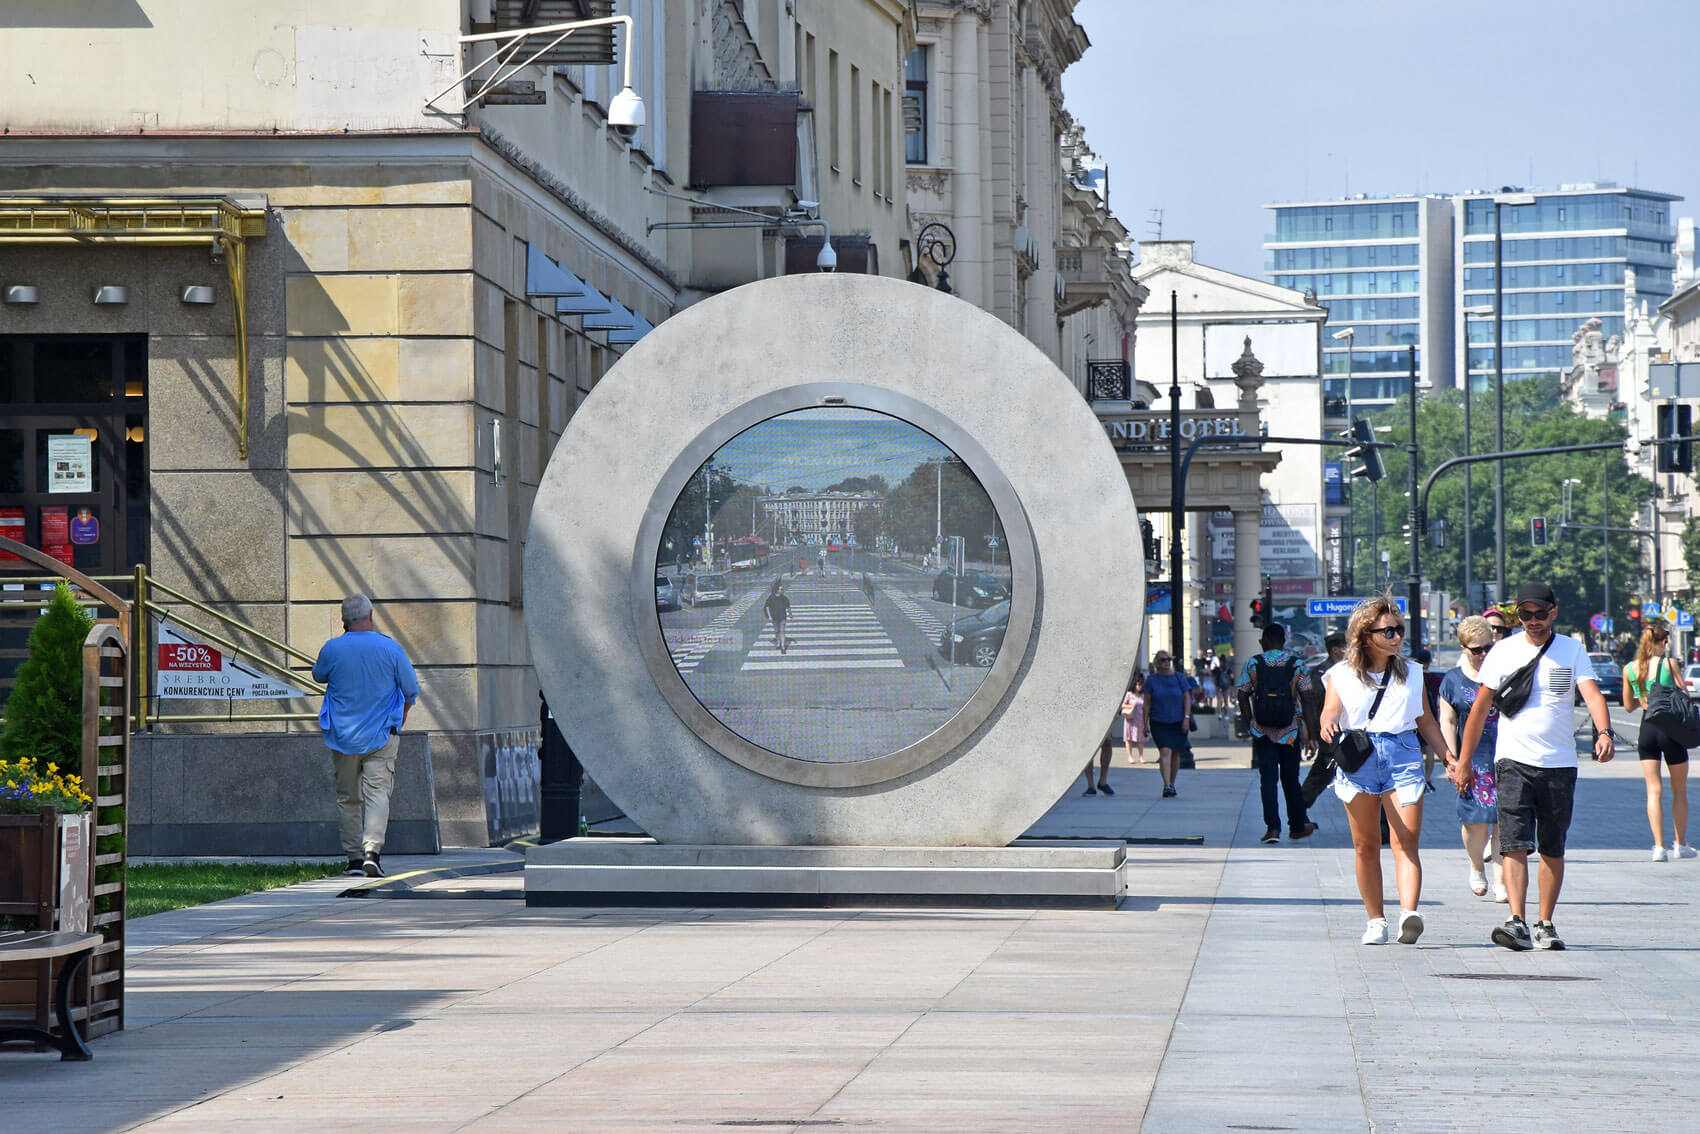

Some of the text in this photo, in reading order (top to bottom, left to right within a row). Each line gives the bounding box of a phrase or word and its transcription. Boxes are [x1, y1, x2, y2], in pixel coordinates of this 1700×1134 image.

[1111, 420, 1246, 438] ND HOTEL
[1313, 603, 1356, 614] ul. Hugon
[169, 647, 211, 662] -50%
[163, 674, 231, 685] SREBRO
[163, 687, 246, 697] KONKURENCYJNE CENY
